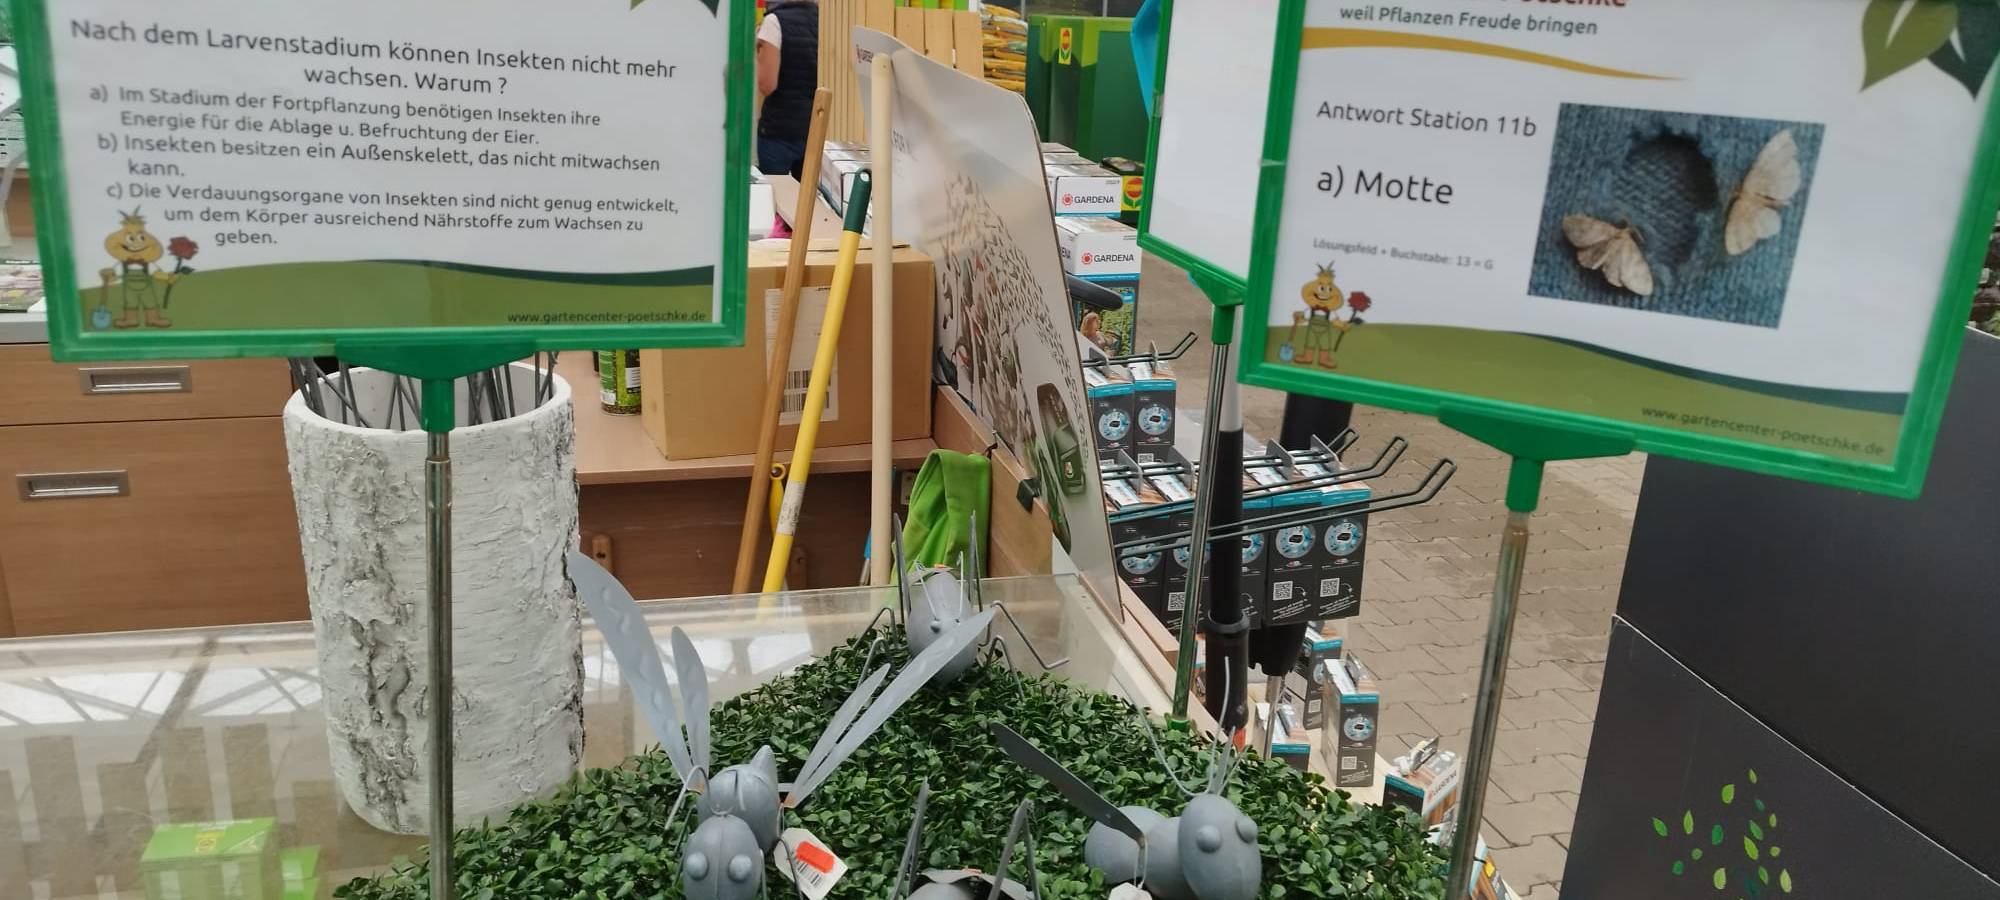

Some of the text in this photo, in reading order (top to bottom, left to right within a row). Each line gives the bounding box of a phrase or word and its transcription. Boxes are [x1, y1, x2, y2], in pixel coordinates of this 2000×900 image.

[1340, 7, 1598, 36] weil Pflanzen Freude bringen
[70, 19, 676, 78] Nach dem Larvenstadium können Insekten nicht mehr
[304, 67, 507, 95] wachsen. Warum ?
[89, 85, 601, 126] a) Im Stadium der Fortpflanzung benötigen Insekten ihre
[1317, 101, 1537, 137] Antwort Station 11b
[120, 110, 540, 144] Energie für die Ablage u. Befruchtung der Eier.
[97, 133, 660, 171] b) Insekten besitzen ein Außenskelett, das nicht mitwachsen
[128, 159, 185, 177] kann.
[106, 182, 679, 214] c) Die Verdauungsorgane von Insekten sind nicht genug entwickelt,
[1317, 165, 1453, 204] a) Motte
[1074, 195, 1114, 204] GARDENA
[164, 206, 643, 231] um dem Körper ausreichend Nährstoffe zum Wachsen zu
[215, 230, 278, 246] geben.
[1094, 254, 1134, 263] GARDENA
[1457, 255, 1472, 267] 13
[1484, 259, 1495, 270] G
[507, 311, 706, 324] www.gartencenter-poetschke.de
[1641, 406, 1885, 455] www.gartencenter-poetschke.de
